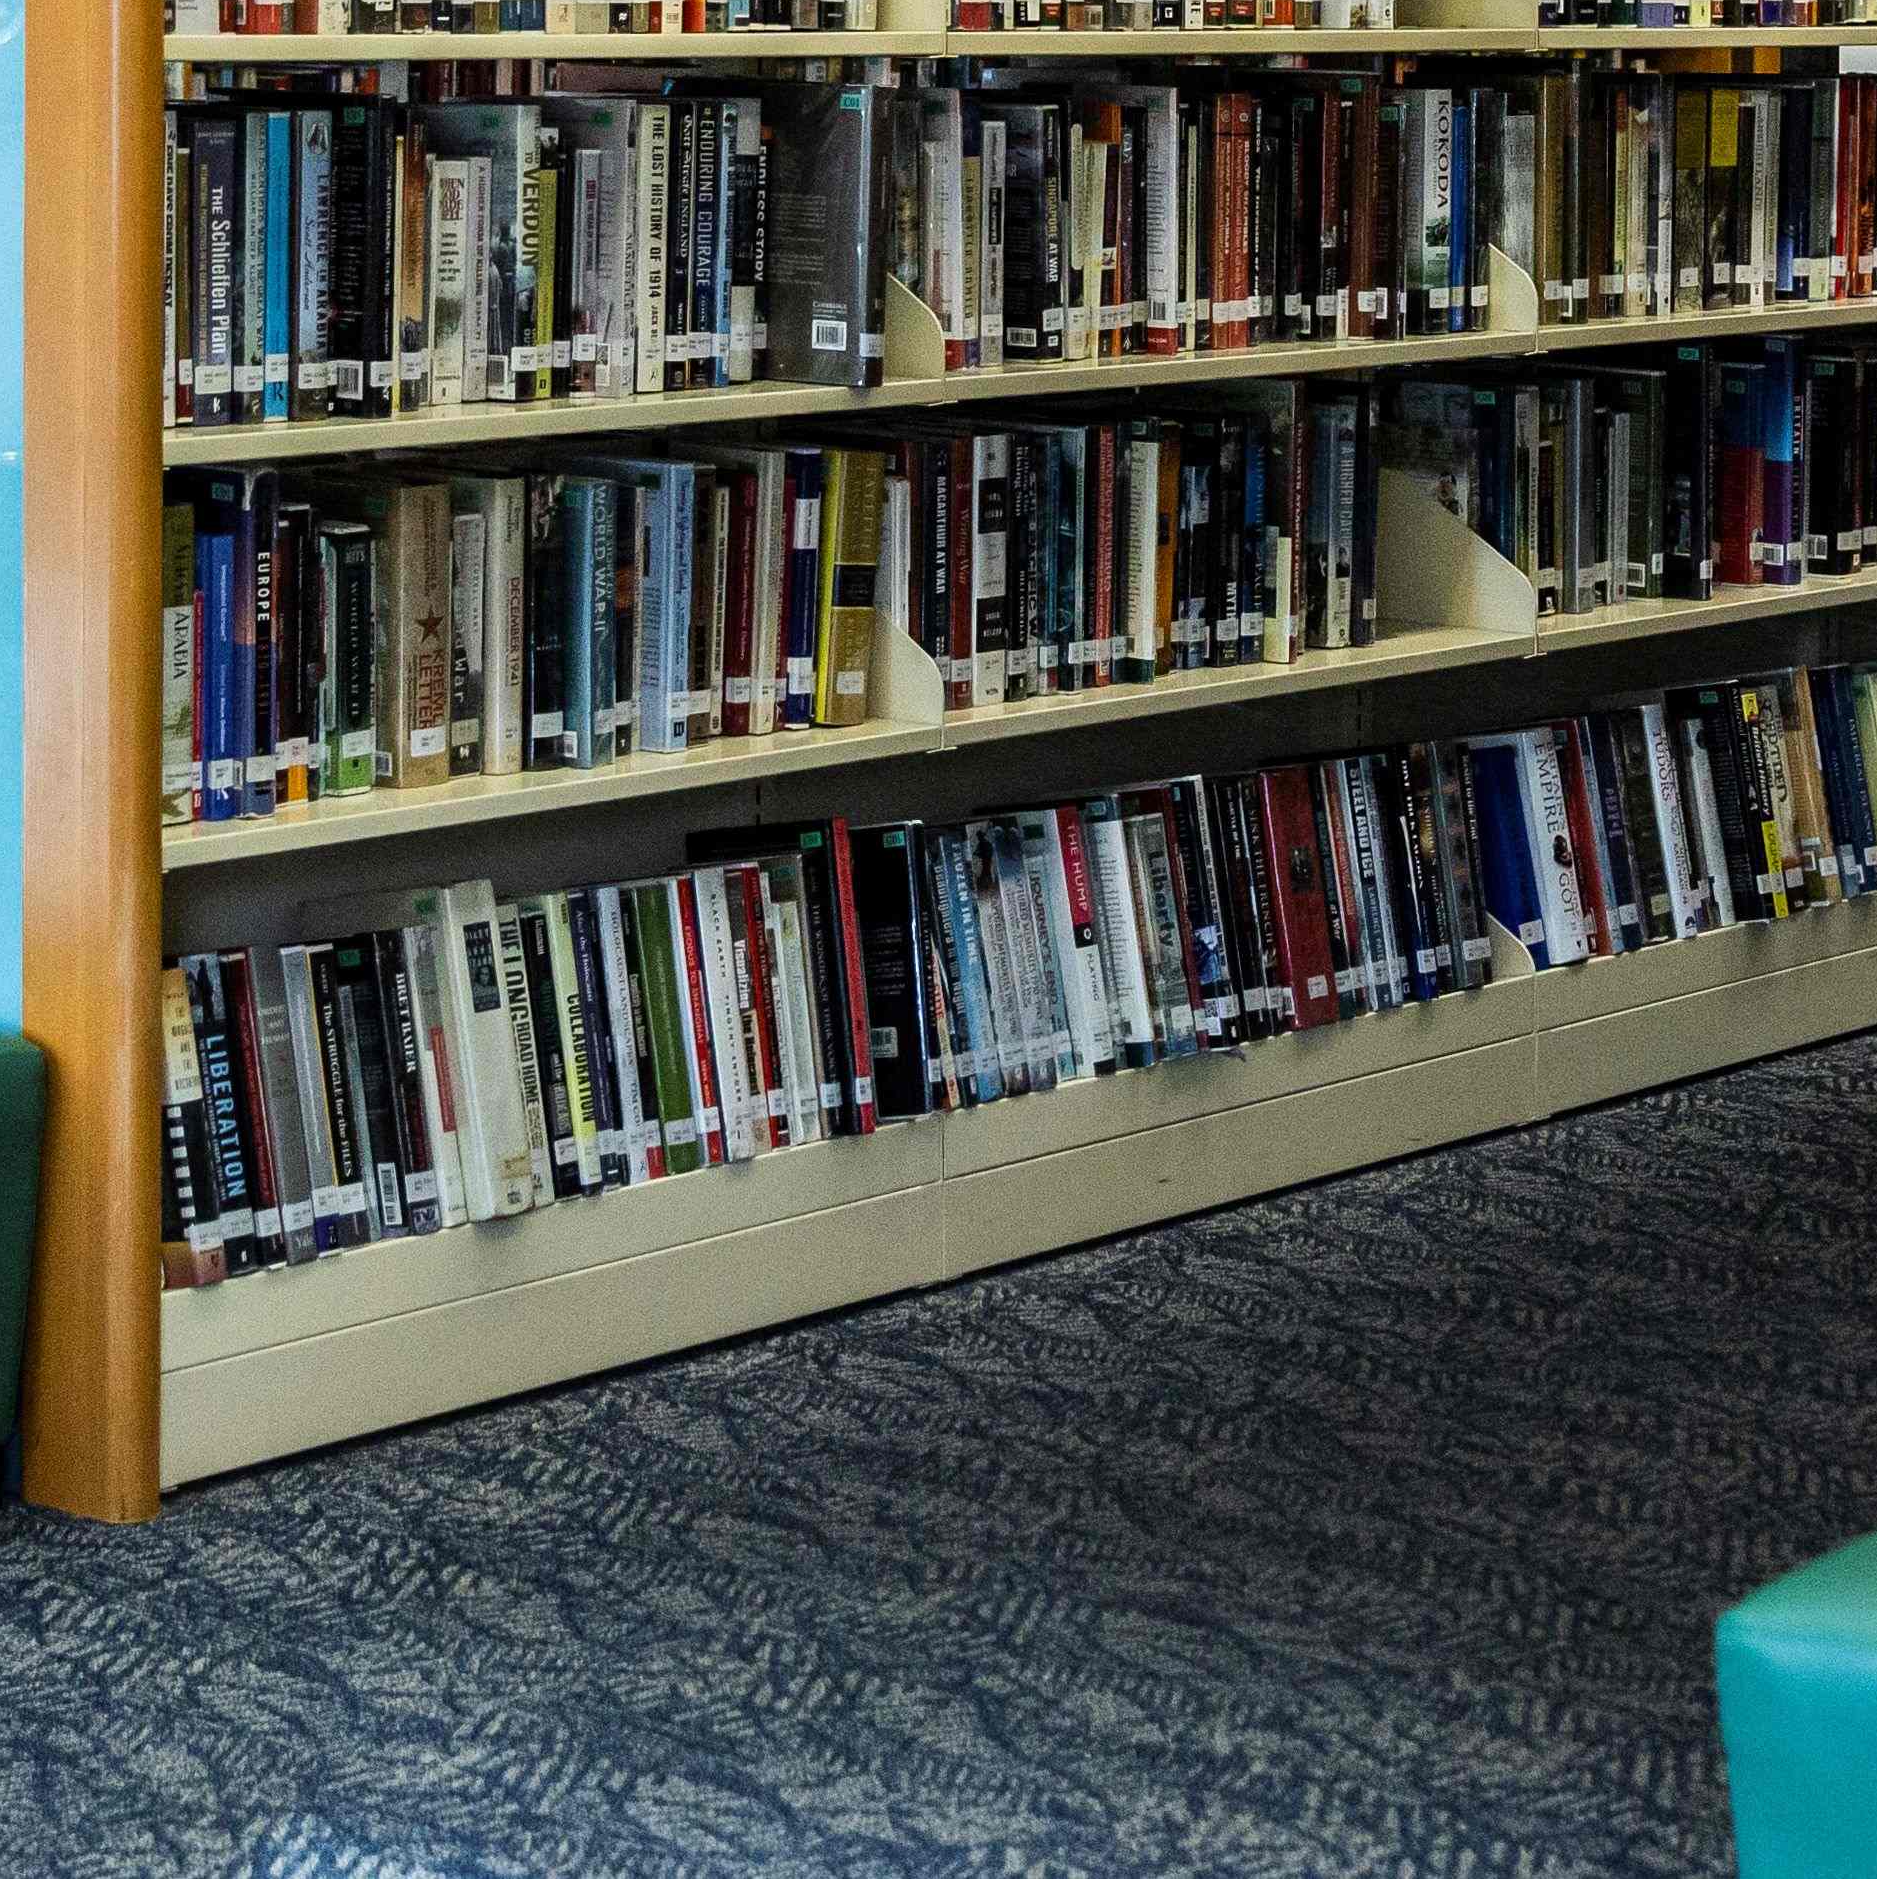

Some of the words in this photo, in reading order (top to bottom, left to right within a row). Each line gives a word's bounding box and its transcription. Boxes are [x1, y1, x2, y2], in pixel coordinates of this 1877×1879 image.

[651, 142, 665, 179] LOST
[652, 114, 666, 142] THE
[697, 119, 715, 204] ENDURING
[1437, 100, 1450, 208] KOKODA
[522, 168, 541, 267] VERDUN
[649, 180, 665, 241] HISTORY
[648, 244, 662, 263] OF
[695, 207, 713, 287] COURAGE
[647, 270, 662, 299] 1914
[206, 1034, 247, 1199] LIBERATION
